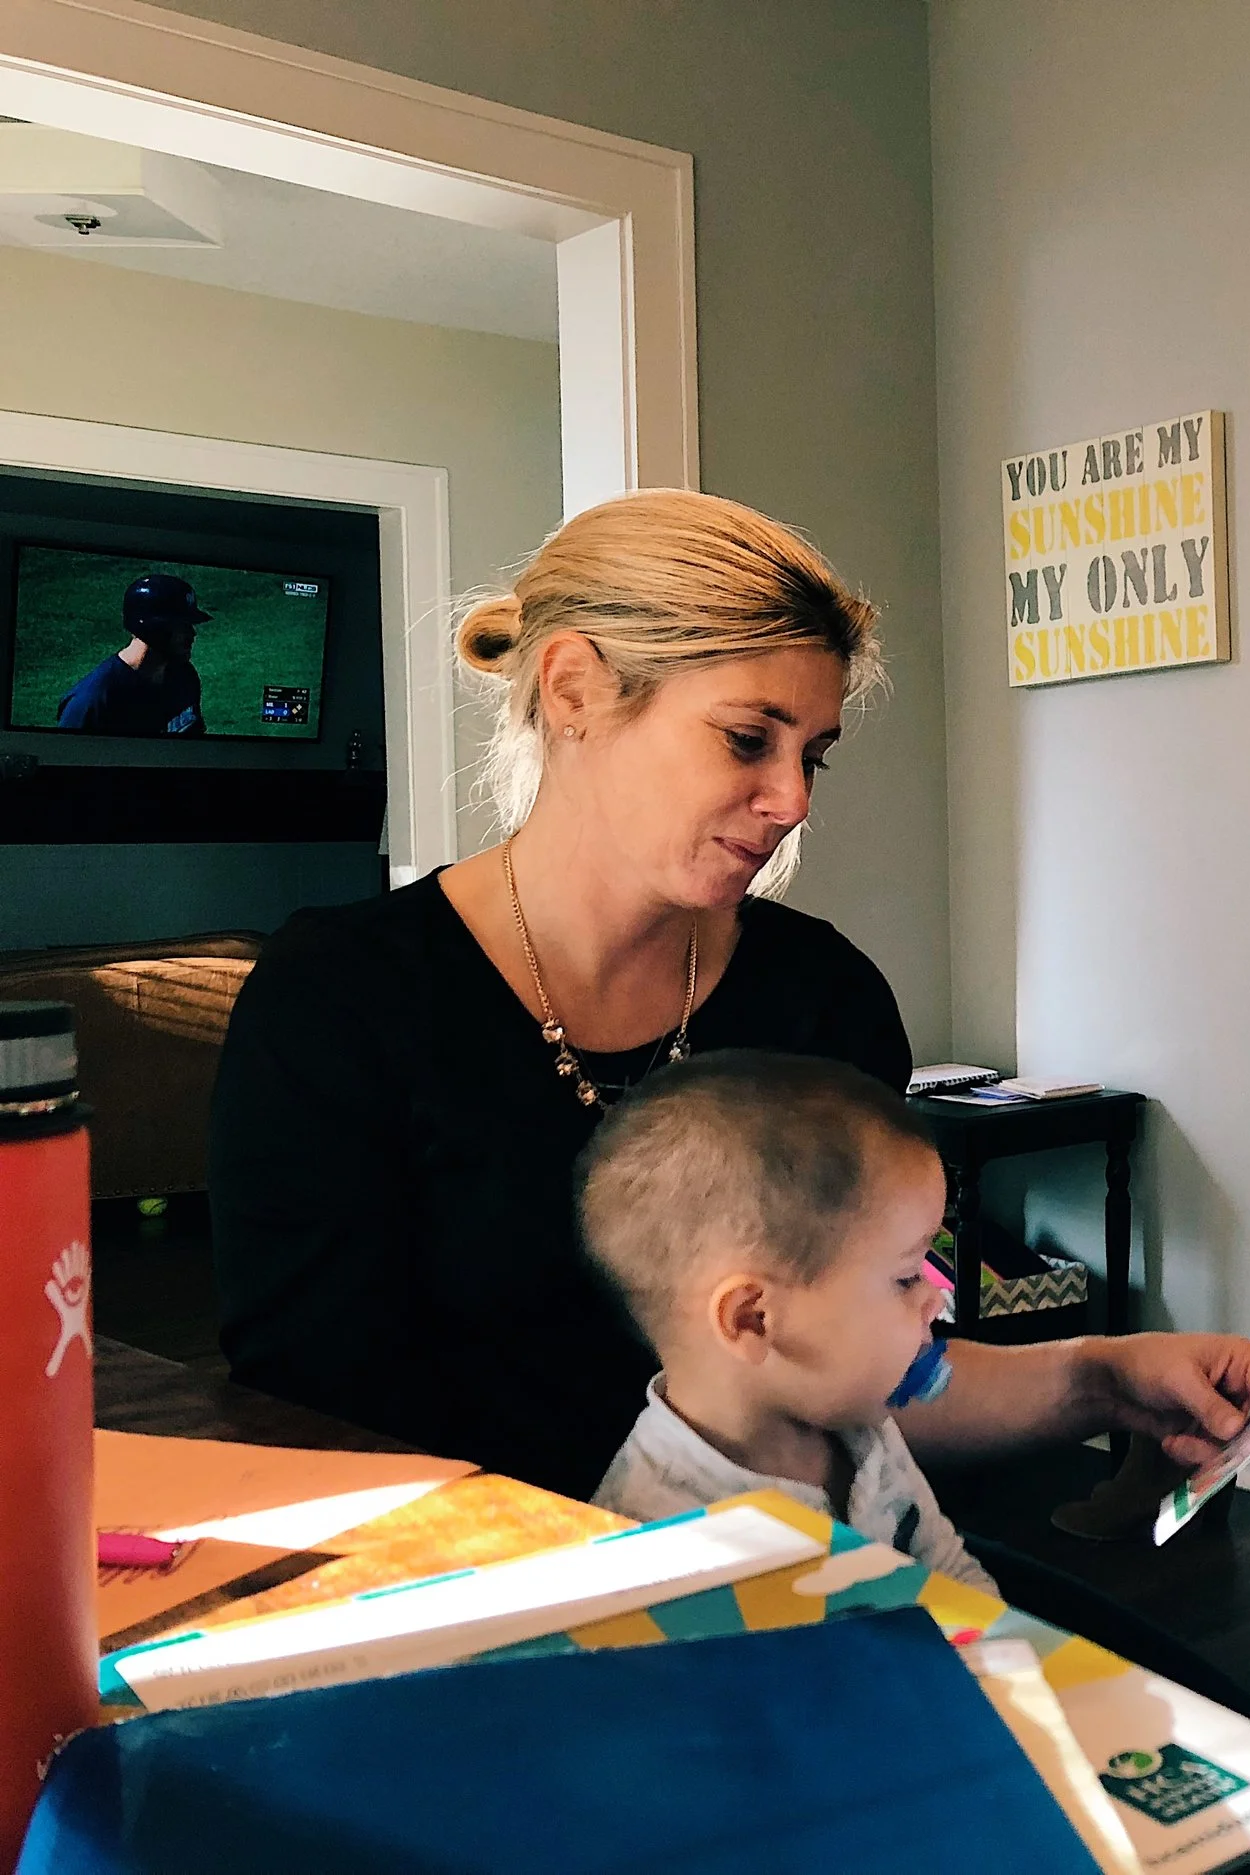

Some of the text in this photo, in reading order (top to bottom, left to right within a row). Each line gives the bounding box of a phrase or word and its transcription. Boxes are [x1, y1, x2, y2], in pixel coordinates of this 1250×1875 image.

[1006, 416, 1203, 502] YOU ARE MY
[1008, 471, 1206, 561] SUNSHINE
[1008, 535, 1210, 628] MY ONLY
[1013, 604, 1211, 683] SUNSHINE
